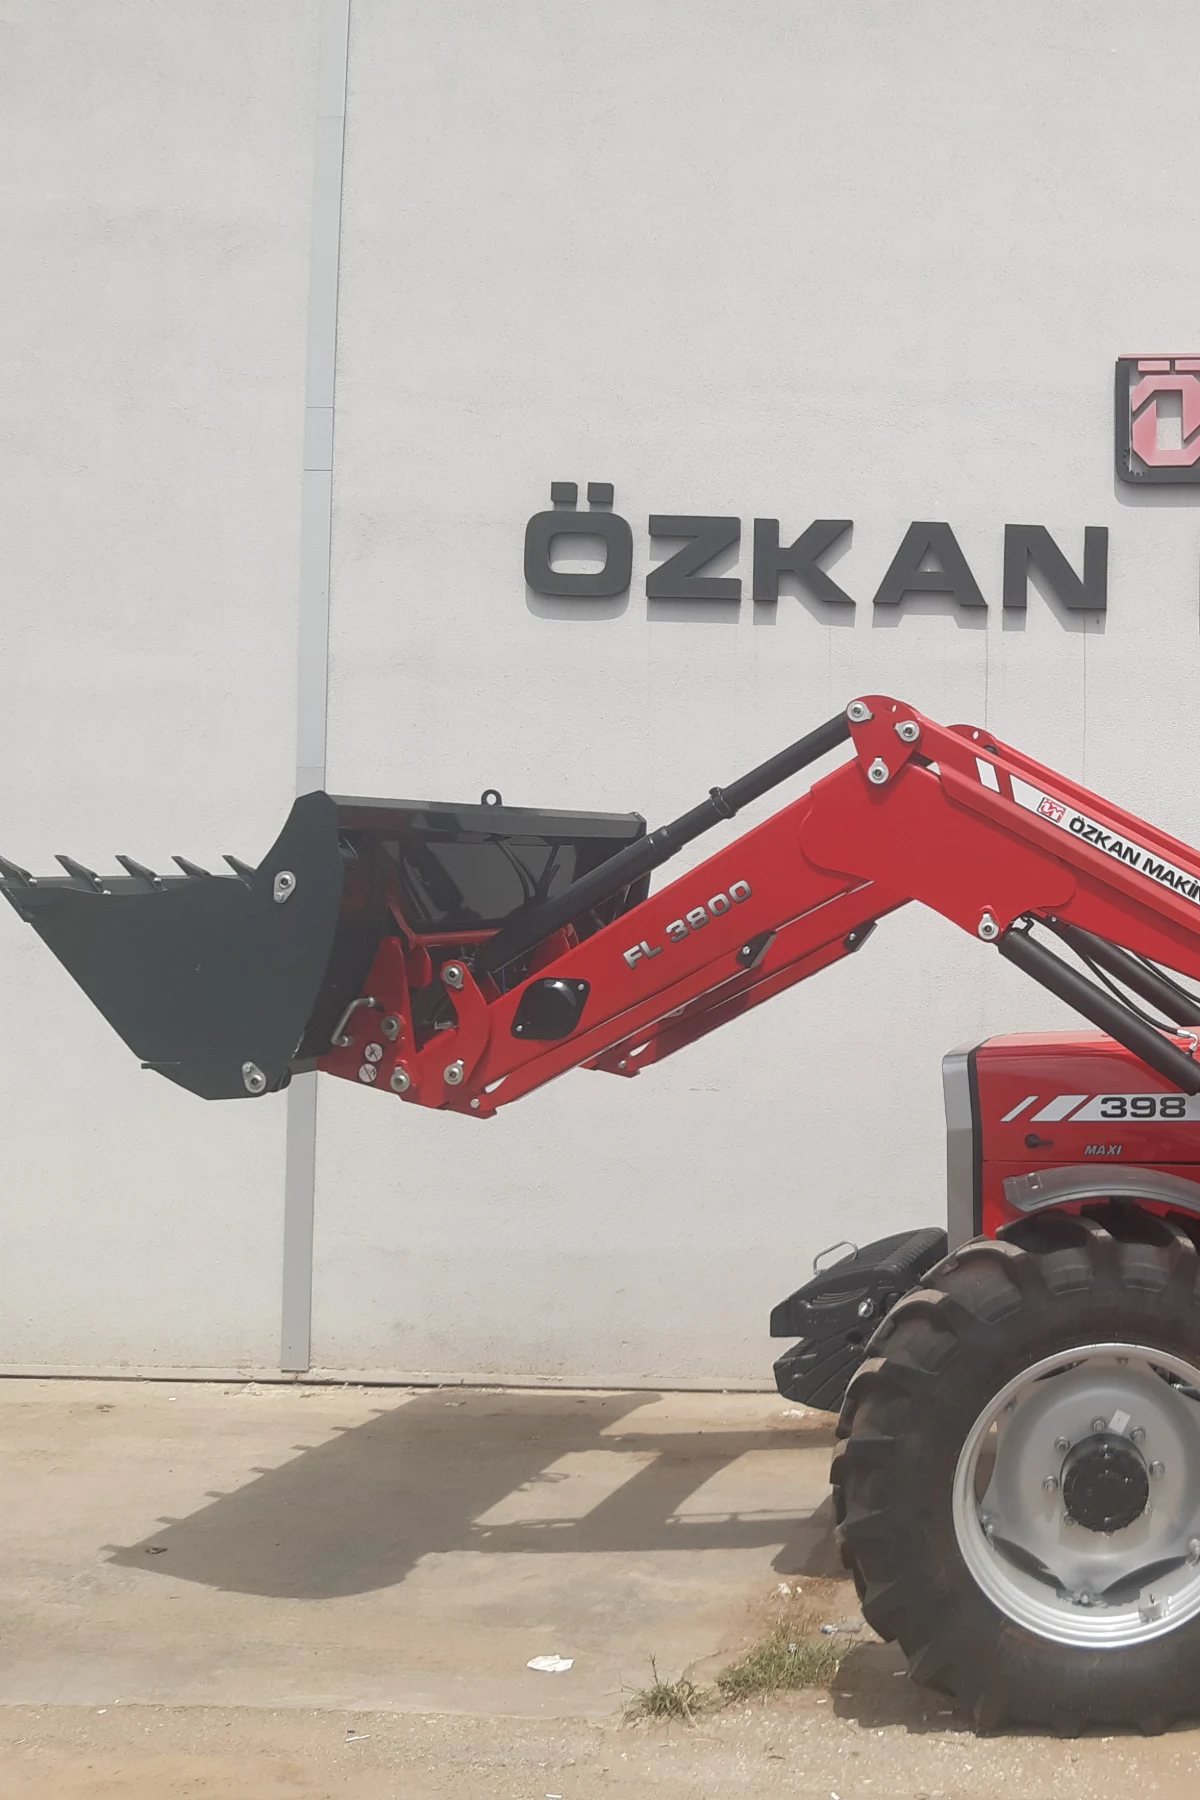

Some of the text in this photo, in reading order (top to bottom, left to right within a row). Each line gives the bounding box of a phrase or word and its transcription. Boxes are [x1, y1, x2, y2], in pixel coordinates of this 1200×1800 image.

[524, 482, 1108, 612] ÖZKAN
[1069, 816, 1141, 865] ÖZKAN
[622, 880, 752, 970] FL 3800
[1100, 1097, 1186, 1118] 398
[1084, 1145, 1122, 1155] MAXI
